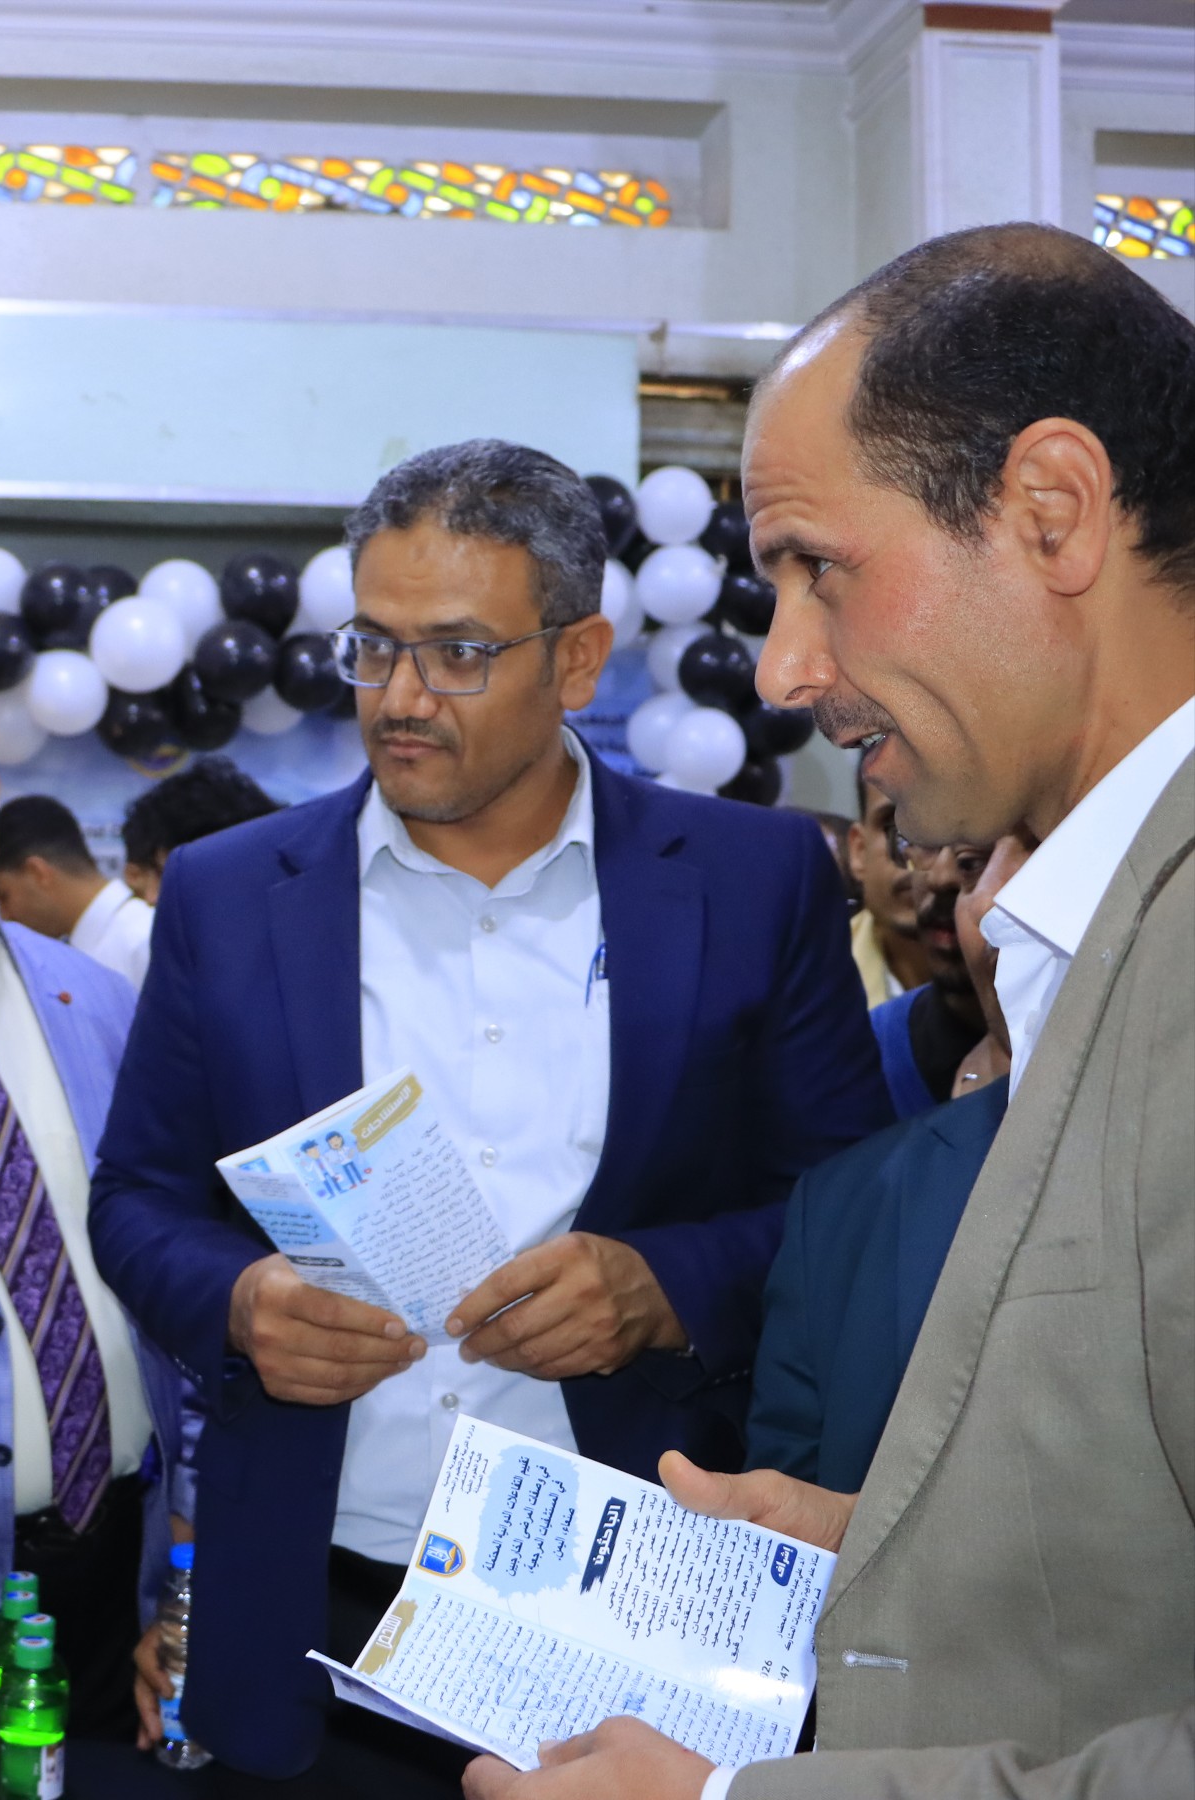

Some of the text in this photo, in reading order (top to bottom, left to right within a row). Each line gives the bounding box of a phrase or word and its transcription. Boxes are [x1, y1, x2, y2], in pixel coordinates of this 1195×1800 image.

[551, 1479, 567, 1494] في
[481, 1455, 531, 1572] تقييم التفاعلات الدوائية المحتملة
[505, 1464, 551, 1577] في وصفات المرضى الخارجيين
[538, 1492, 559, 1537] المستشفيات
[640, 1514, 651, 1538] عبده
[552, 1507, 576, 1562] صنعاء، اليمن.
[593, 1505, 621, 1565] الباحثون
[649, 1533, 657, 1554] عمر
[669, 1531, 682, 1560] مسعد
[692, 1532, 704, 1560] الدين
[729, 1525, 742, 1554] شرف
[742, 1529, 752, 1552] اكرم
[750, 1535, 762, 1559] عقيل
[656, 1535, 669, 1564] محمد
[678, 1538, 691, 1567] محمد
[701, 1542, 713, 1567] احمد
[760, 1538, 774, 1569] حسين
[776, 1546, 793, 1578] إشراف
[650, 1566, 659, 1586] نور
[658, 1562, 672, 1592] محمد
[683, 1561, 696, 1587] احمد
[704, 1567, 717, 1596] محمد
[720, 1555, 732, 1583] الدين
[732, 1553, 745, 1581] محمد
[608, 1580, 619, 1610] ناجي
[668, 1569, 681, 1599] محمد
[711, 1585, 724, 1608] خالد
[637, 1589, 651, 1619] الدين
[740, 1605, 752, 1632] احمد
[710, 1620, 724, 1648] سعيد
